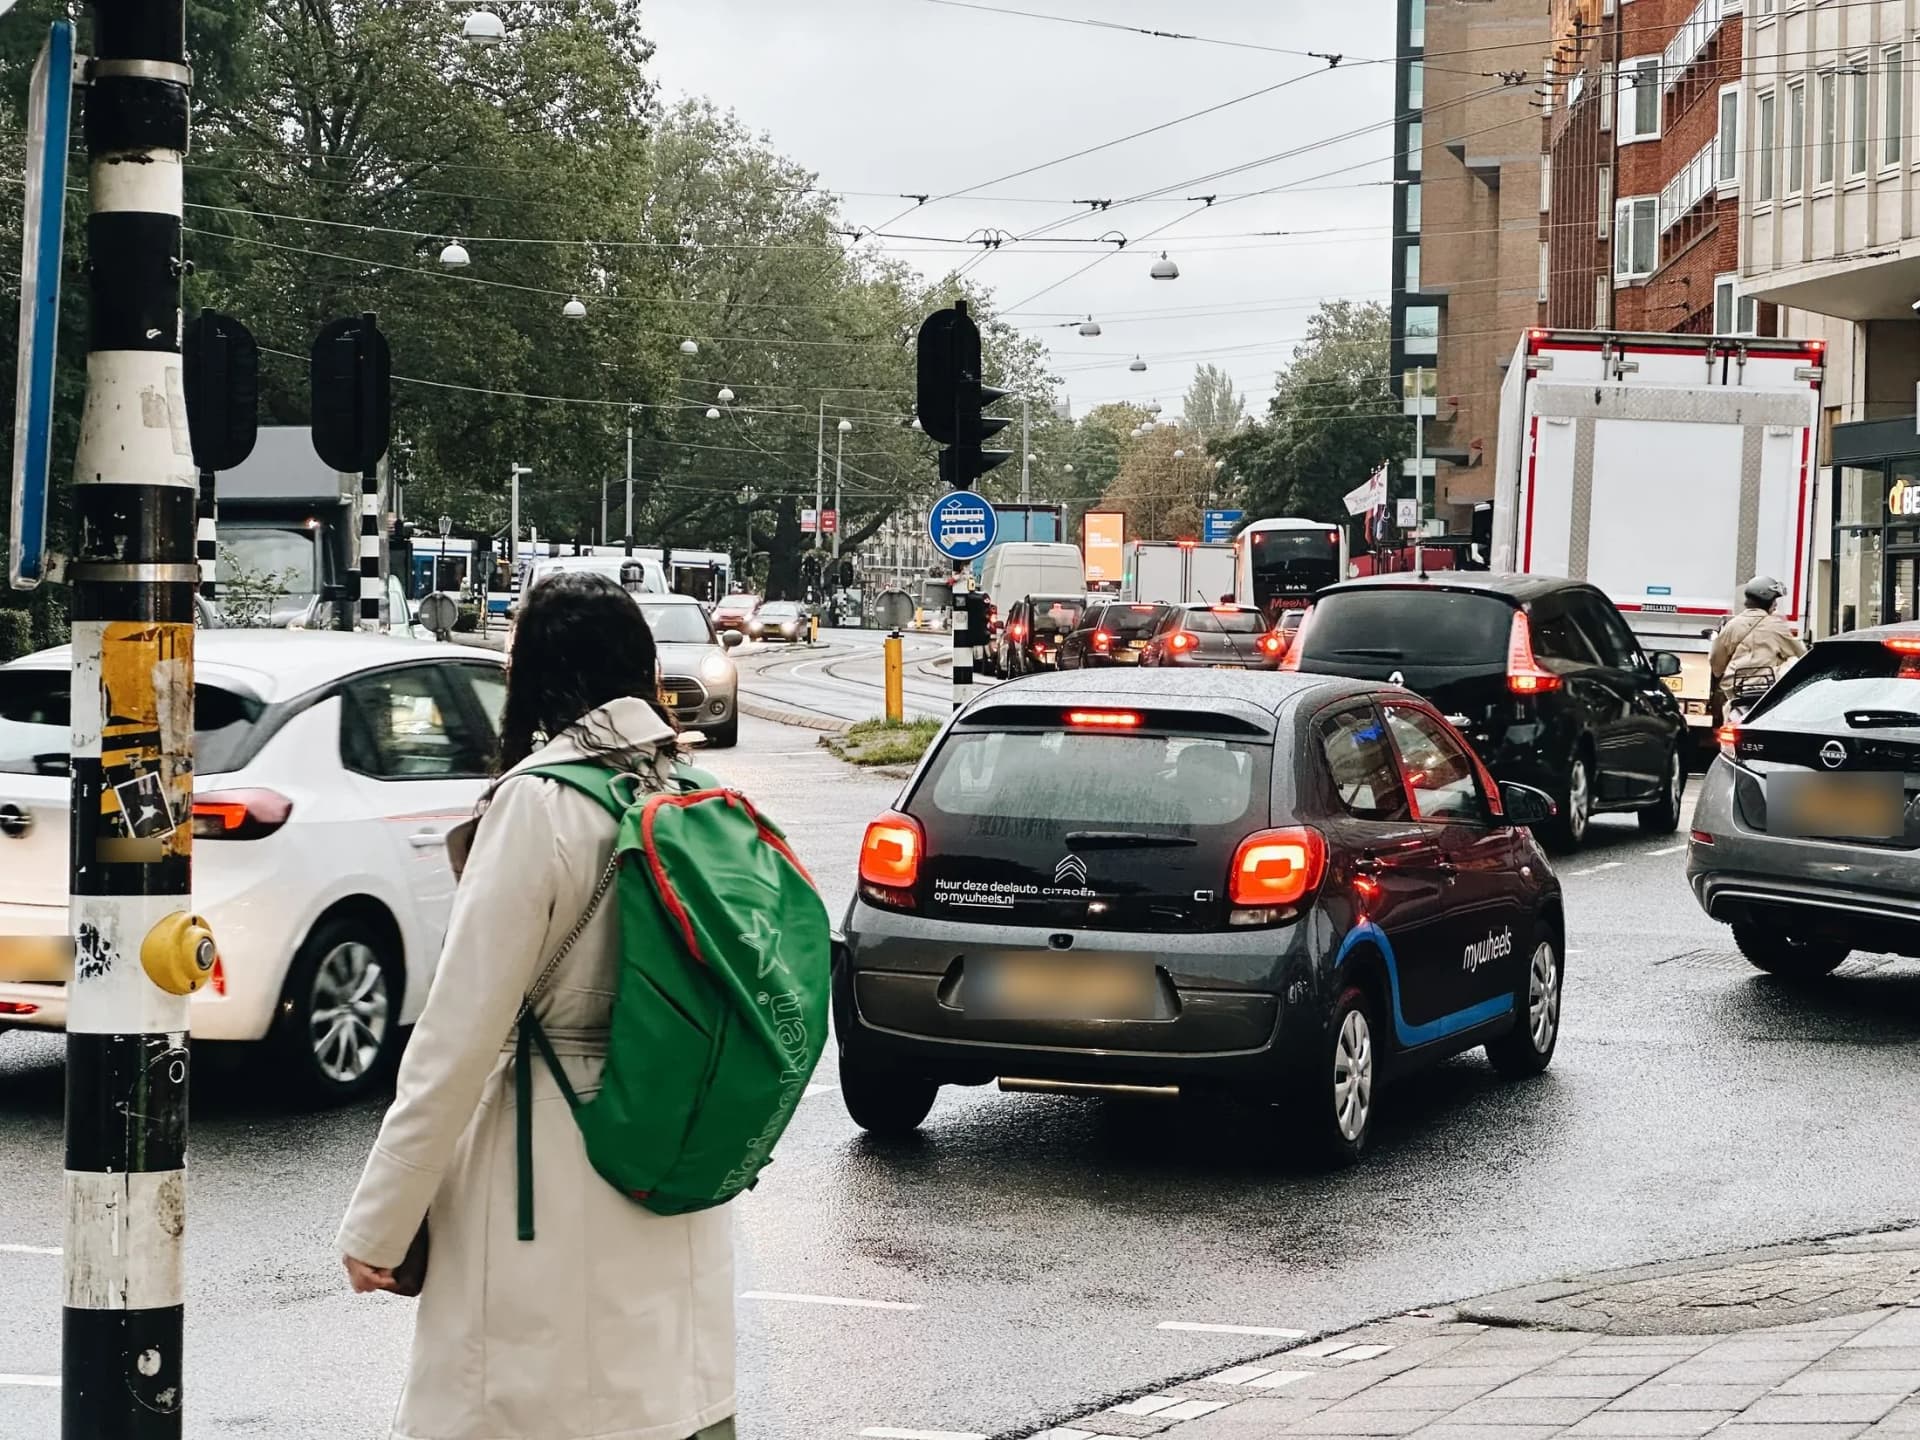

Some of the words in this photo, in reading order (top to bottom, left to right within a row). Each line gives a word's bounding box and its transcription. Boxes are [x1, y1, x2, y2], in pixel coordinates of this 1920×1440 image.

[1742, 743, 1764, 752] LEAF
[1820, 751, 1847, 759] NISSAN
[935, 879, 962, 889] Huur
[962, 880, 989, 891] deze
[990, 881, 1038, 894] deelauto
[934, 892, 948, 903] op
[949, 892, 1014, 905] mywheels.nl
[1194, 890, 1214, 902] C1
[1462, 924, 1512, 973] mywheels
